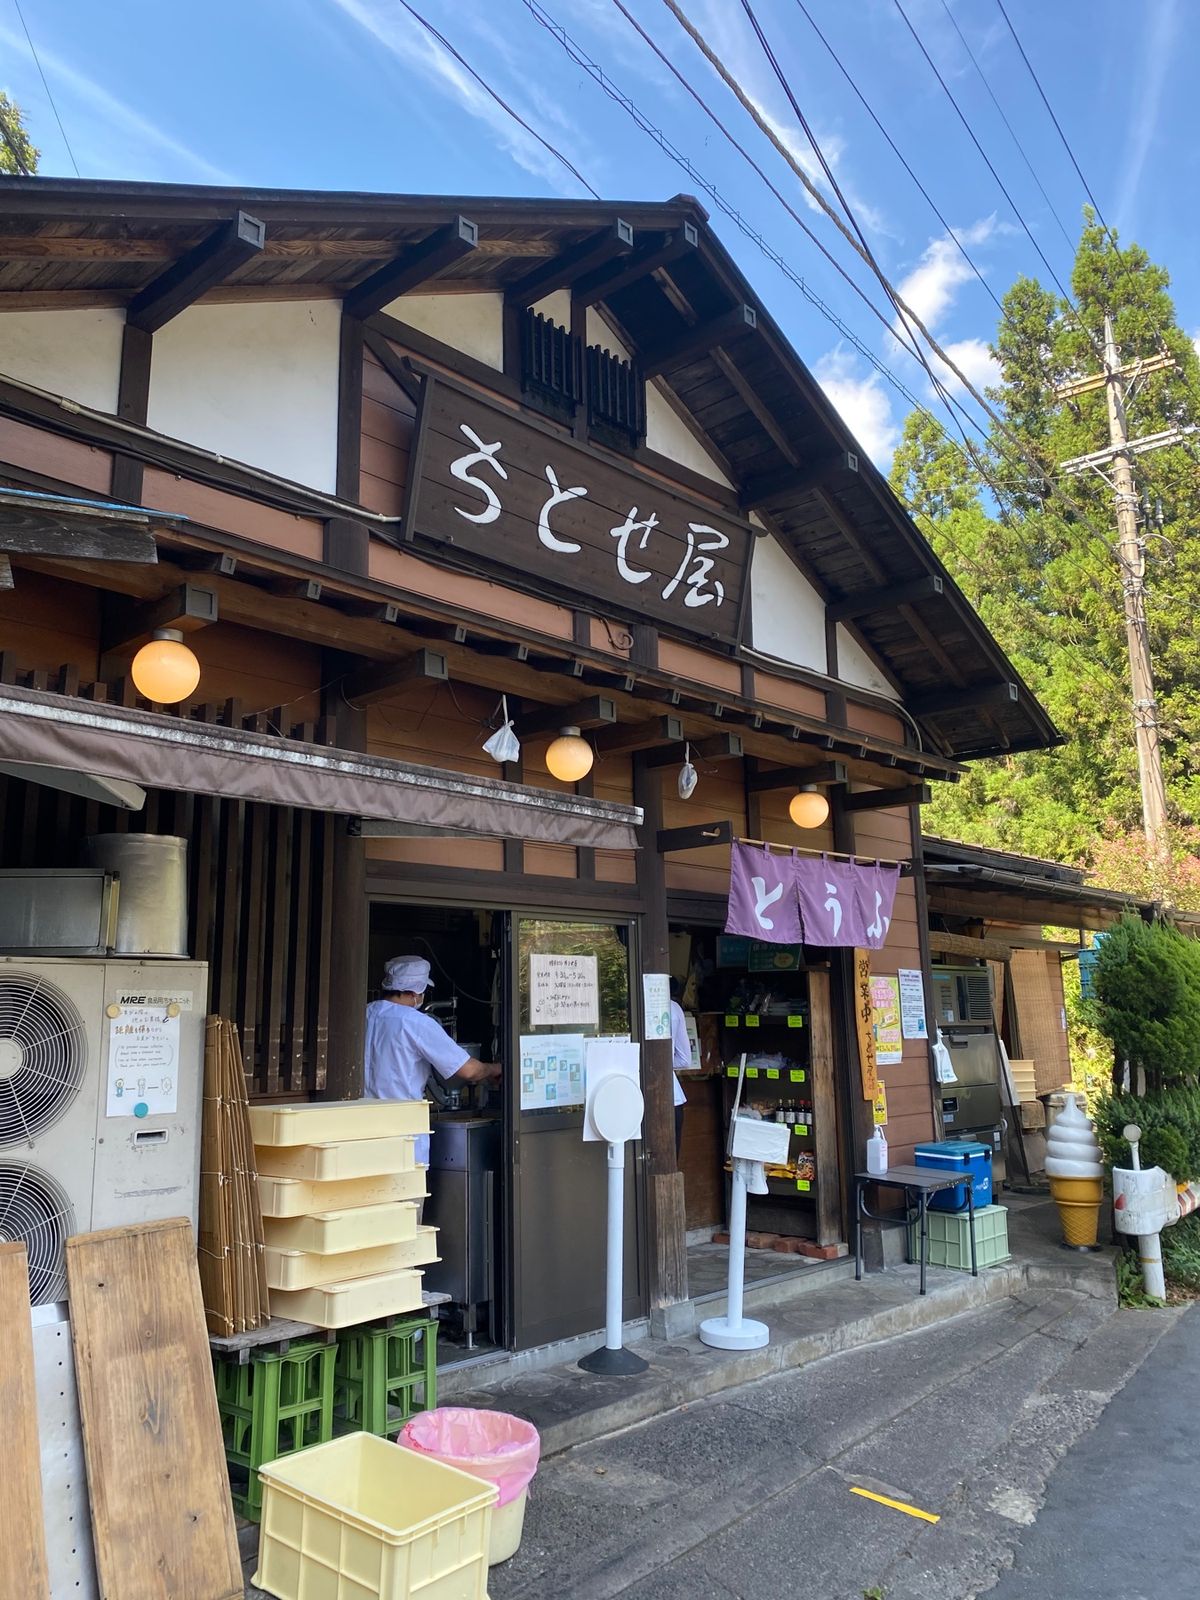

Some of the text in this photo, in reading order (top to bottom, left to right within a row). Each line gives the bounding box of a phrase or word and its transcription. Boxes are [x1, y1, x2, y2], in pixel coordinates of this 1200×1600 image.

[449, 423, 731, 608] ちとせ屋
[751, 876, 890, 939] とうふ
[120, 996, 147, 1004] MRE
[858, 959, 872, 1023] 営業中
